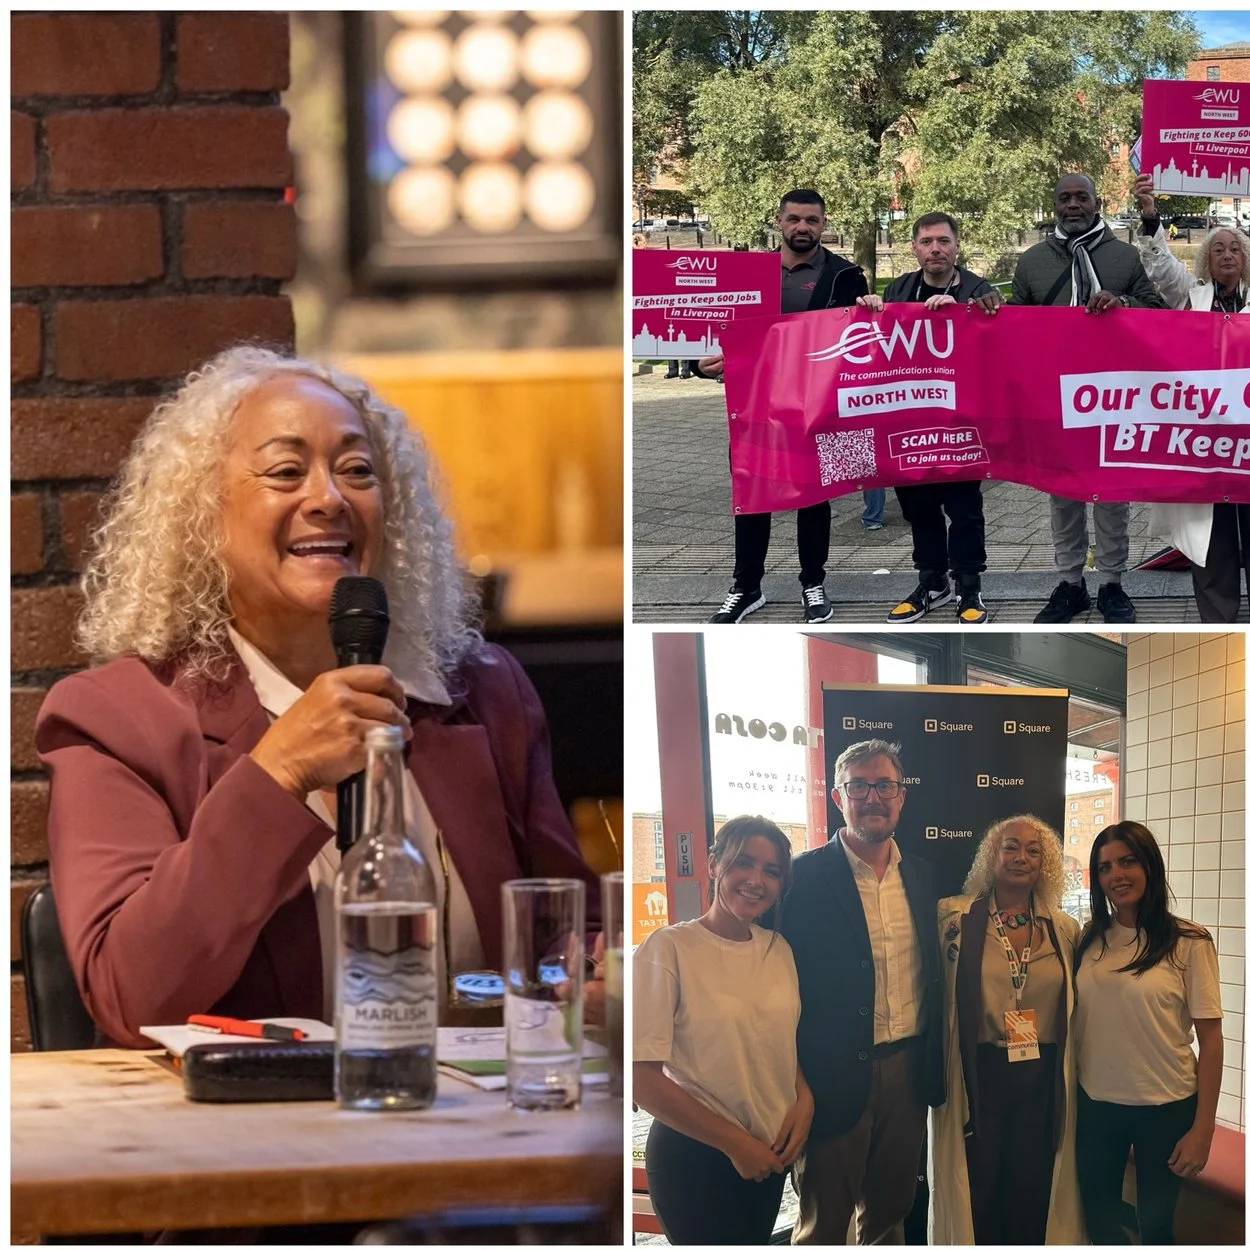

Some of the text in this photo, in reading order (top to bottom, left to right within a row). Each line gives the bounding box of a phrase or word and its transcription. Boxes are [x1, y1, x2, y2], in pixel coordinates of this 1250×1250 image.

[1199, 88, 1239, 103] CWU
[1164, 131, 1200, 141] Fighting
[1214, 130, 1236, 140] Keep
[1206, 144, 1248, 155] Liverpool
[670, 256, 717, 271] CWU
[635, 296, 675, 307] Fighting
[691, 295, 714, 305] Keep
[717, 294, 734, 303] 600
[735, 294, 756, 303] Jobs
[671, 308, 728, 321] in Liverpool
[830, 319, 954, 364] CWU
[839, 367, 955, 381] The communications union
[848, 388, 948, 408] NORTH WEST
[1073, 384, 1140, 413] Our
[1150, 380, 1229, 419] City,
[901, 432, 972, 448] SCAN HERE
[1114, 424, 1160, 452] BT
[919, 453, 937, 464] join
[952, 451, 982, 462] today!
[858, 720, 892, 730] Square
[940, 722, 973, 732] Square
[1019, 723, 1050, 733] Square
[992, 777, 1024, 786] Square
[940, 829, 972, 839] Square
[680, 835, 689, 874] PUSH
[355, 1008, 427, 1020] MARLISH
[1008, 1042, 1037, 1050] community
